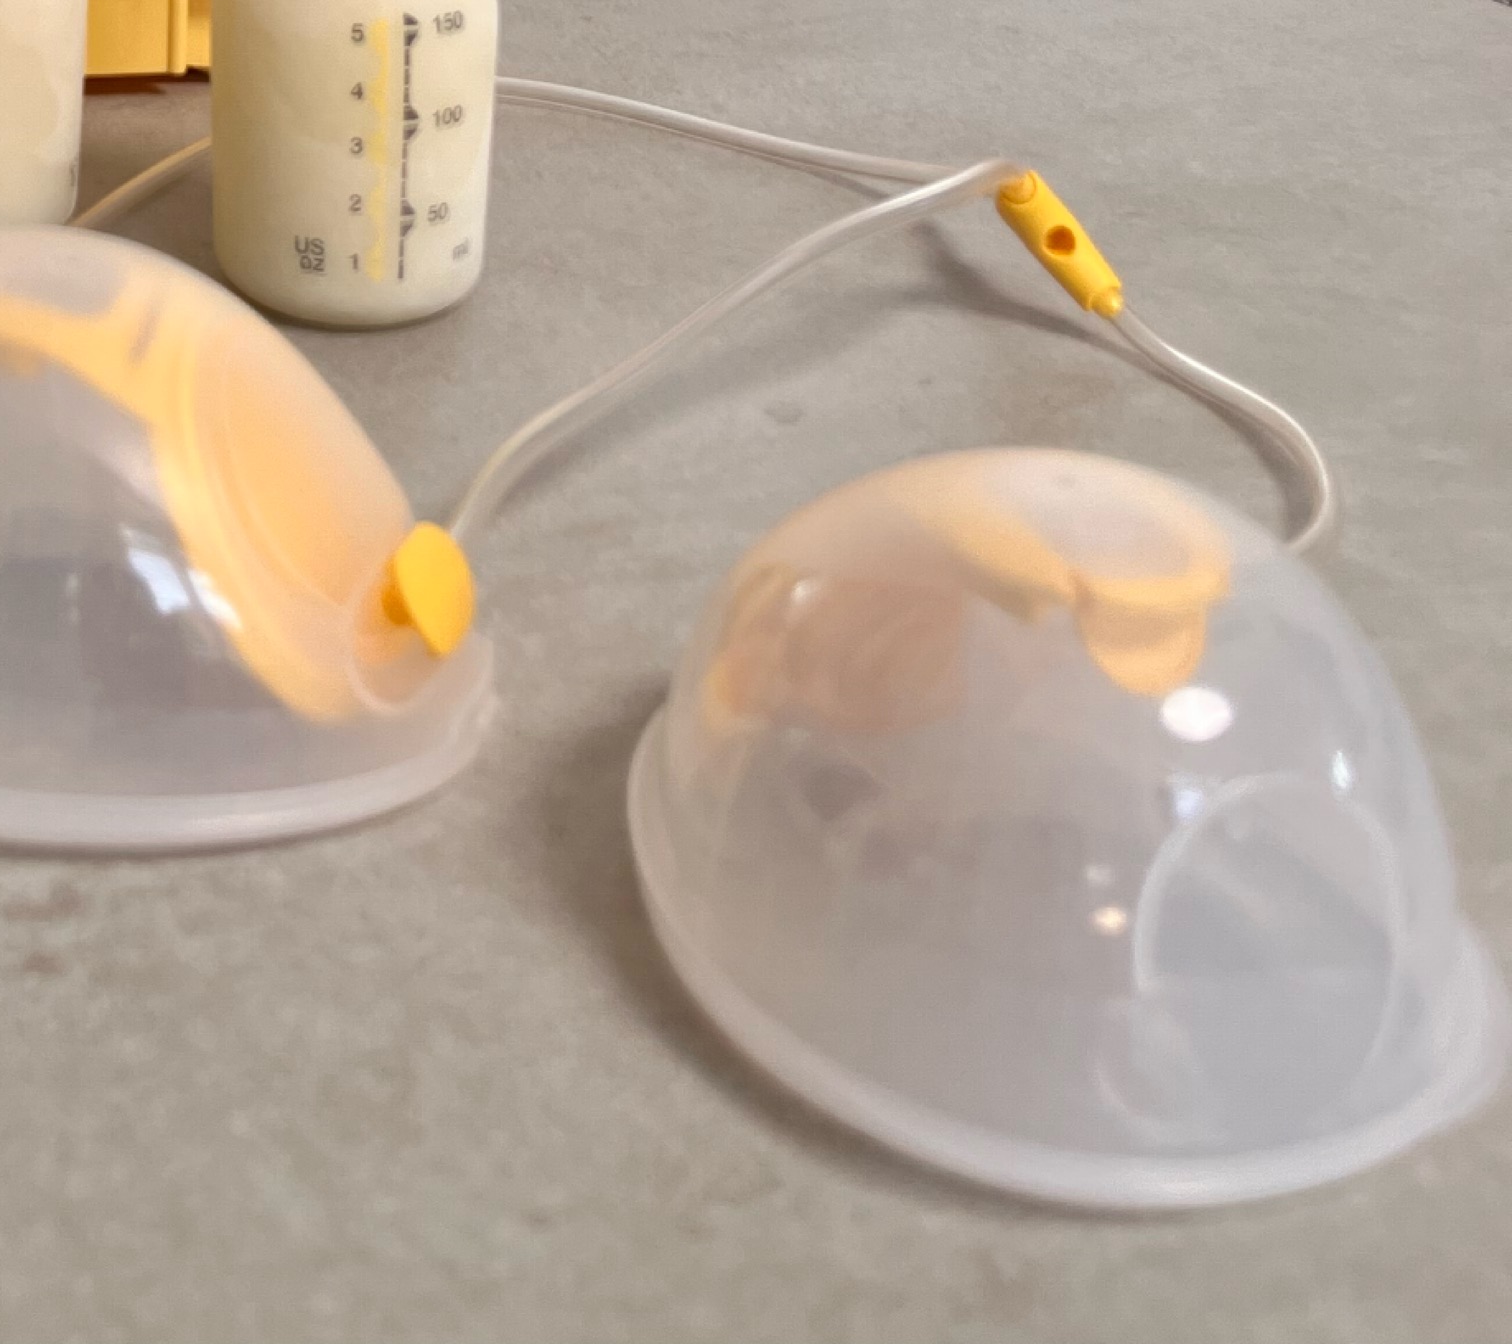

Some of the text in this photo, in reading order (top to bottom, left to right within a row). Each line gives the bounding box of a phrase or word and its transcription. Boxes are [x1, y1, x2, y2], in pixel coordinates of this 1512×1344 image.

[433, 11, 464, 34] 150
[351, 23, 365, 43] 5
[350, 82, 364, 101] 4
[433, 105, 463, 127] 100
[349, 137, 363, 155] 3
[348, 194, 363, 212] 2
[427, 203, 449, 223] 50
[294, 236, 325, 255] US
[349, 253, 359, 270] 1
